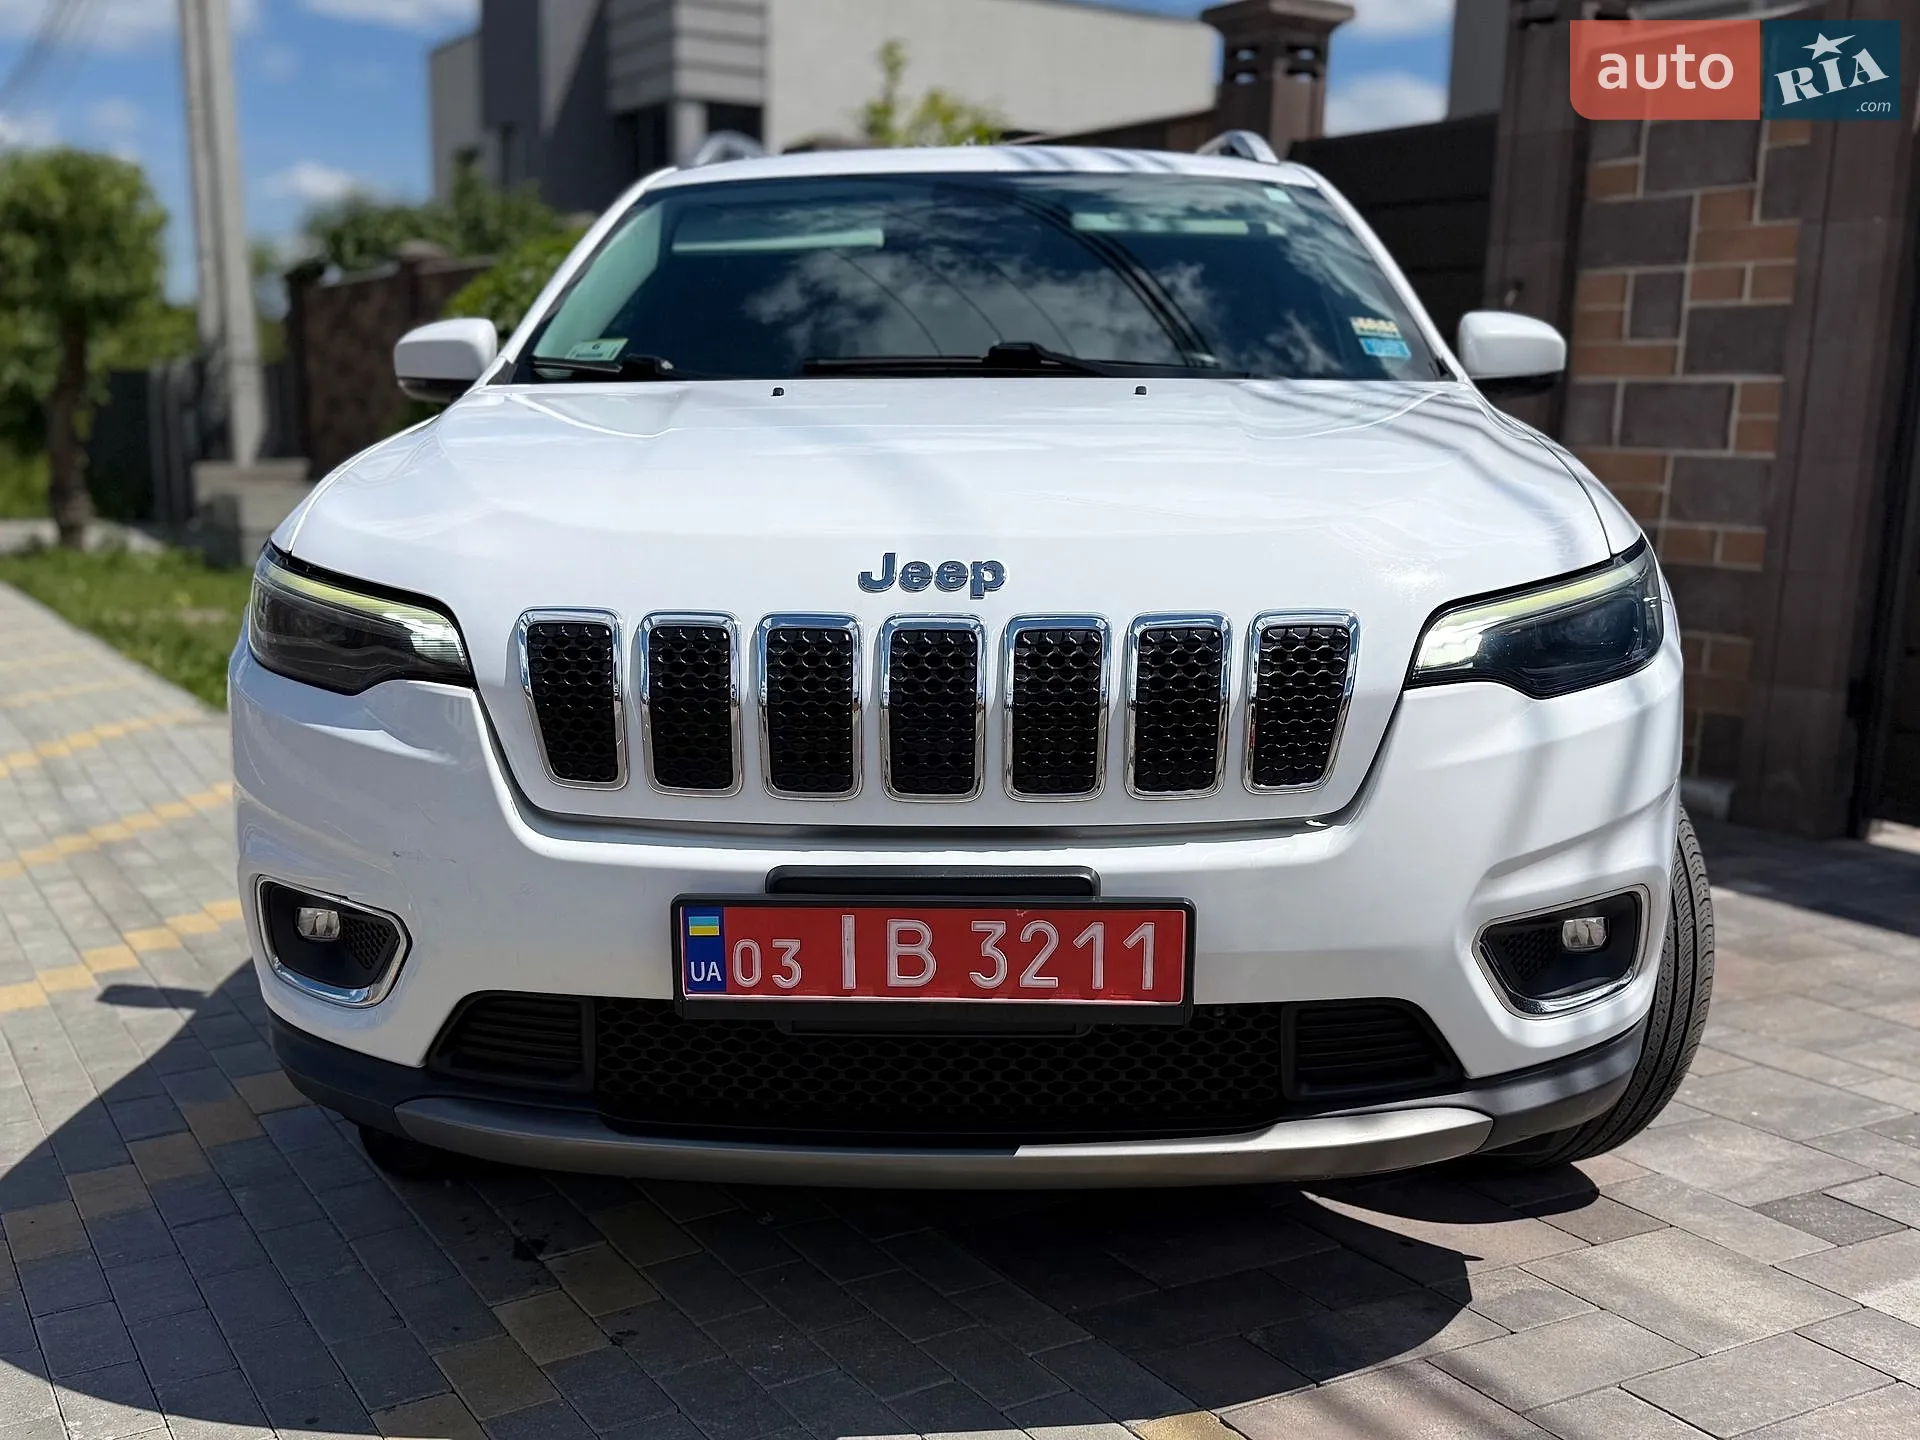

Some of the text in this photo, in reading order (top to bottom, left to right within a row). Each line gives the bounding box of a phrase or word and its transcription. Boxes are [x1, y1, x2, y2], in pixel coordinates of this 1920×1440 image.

[858, 552, 1006, 600] Jeep
[690, 962, 722, 982] UA
[732, 939, 802, 988] 03
[969, 920, 1155, 990] 3211
